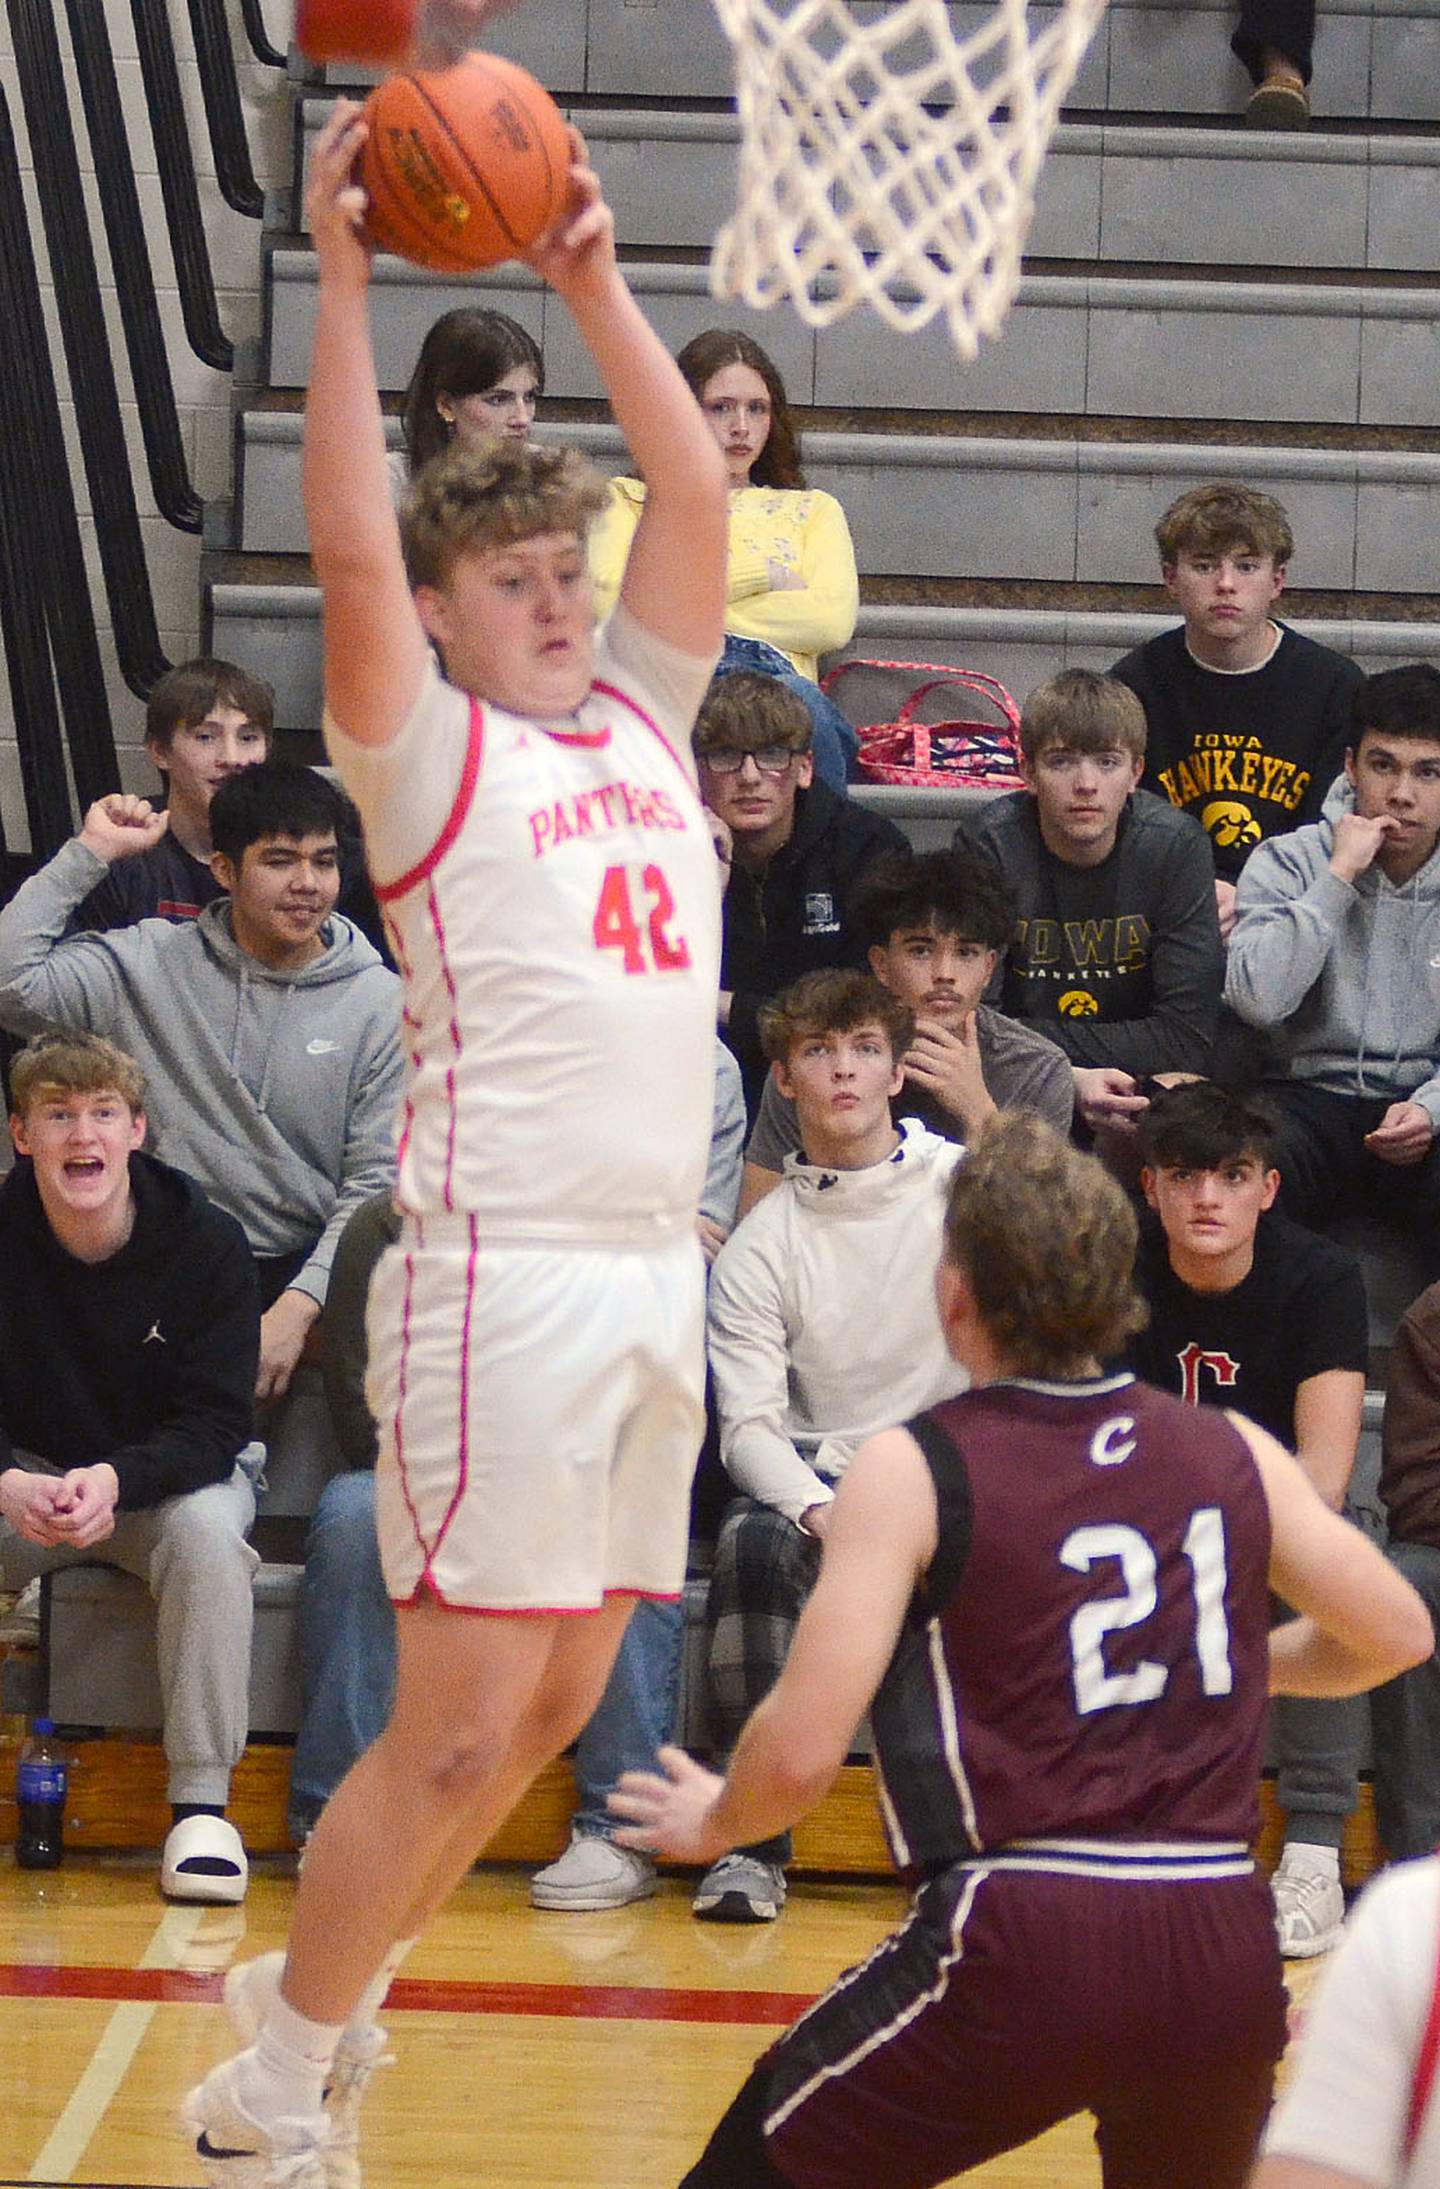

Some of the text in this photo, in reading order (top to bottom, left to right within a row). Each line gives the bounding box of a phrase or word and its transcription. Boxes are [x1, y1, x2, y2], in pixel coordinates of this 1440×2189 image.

[1193, 733, 1264, 749] IOWA
[1157, 749, 1312, 810] HAWKEYES
[529, 781, 687, 860] PANTERS
[592, 863, 693, 976] 42
[1089, 1415, 1138, 1466] C
[1058, 1504, 1234, 1716] 21
